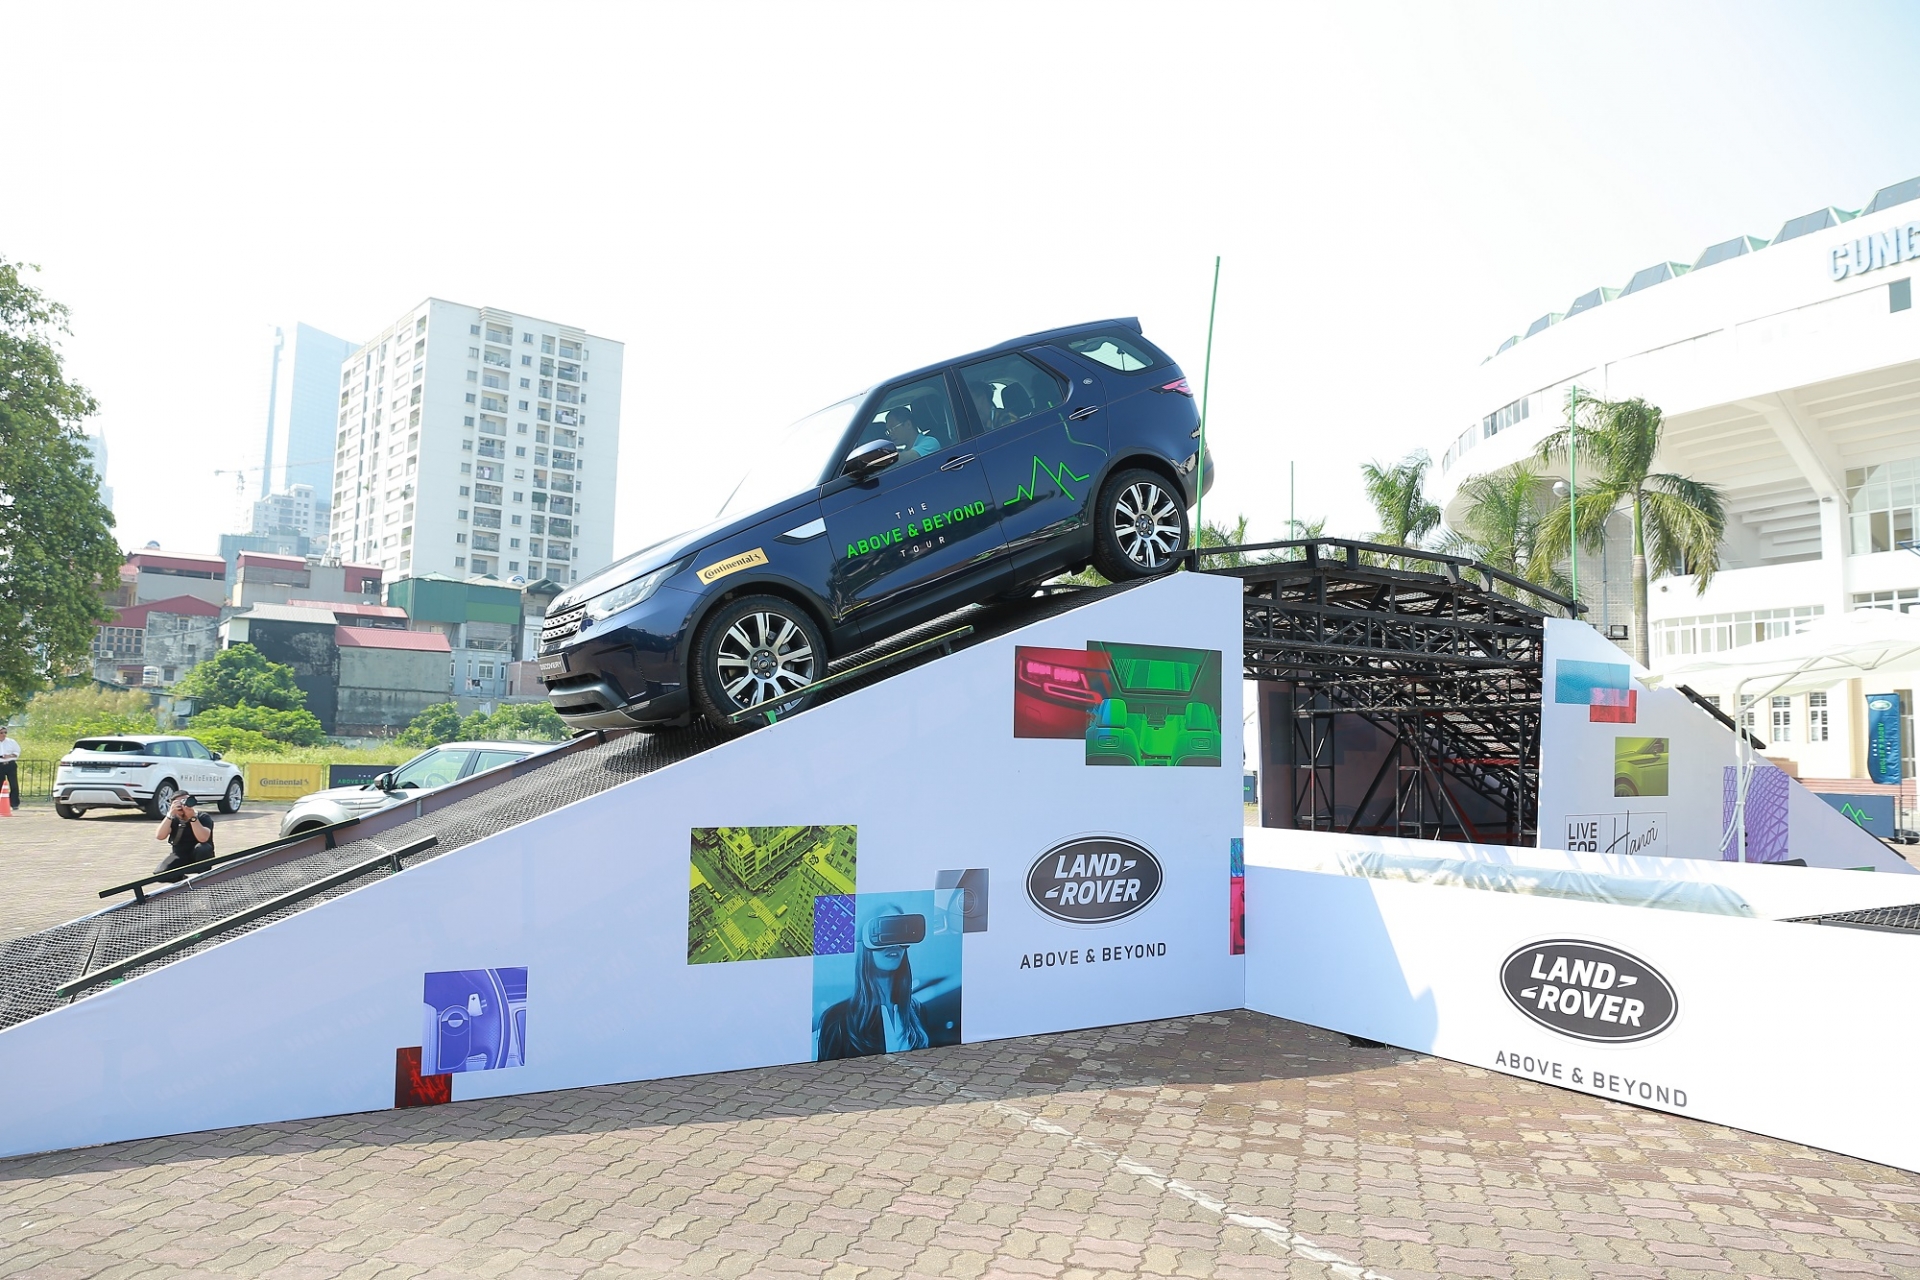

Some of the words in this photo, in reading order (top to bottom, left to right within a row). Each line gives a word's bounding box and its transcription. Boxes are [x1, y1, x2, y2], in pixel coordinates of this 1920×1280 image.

[1827, 221, 1920, 282] CUNG
[895, 502, 928, 520] THE
[847, 528, 904, 559] ABOVE
[907, 523, 919, 538] &
[921, 500, 986, 533] BEYOND
[900, 536, 946, 557] TOUR
[704, 554, 754, 579] Continental
[260, 777, 303, 787] Continental
[1568, 822, 1598, 840] LIVE
[1605, 809, 1659, 855] Hanoi
[1054, 853, 1122, 879] LAND
[1059, 878, 1141, 906] ROVER
[1020, 950, 1079, 970] ABOVE
[1085, 948, 1096, 963] &
[1102, 942, 1167, 962] BEYOND
[1530, 953, 1617, 990] LAND
[1537, 984, 1645, 1028] ROVER
[1495, 1050, 1562, 1079] ABOVE
[1571, 1067, 1584, 1085] &
[1593, 1071, 1688, 1108] BEYOND
